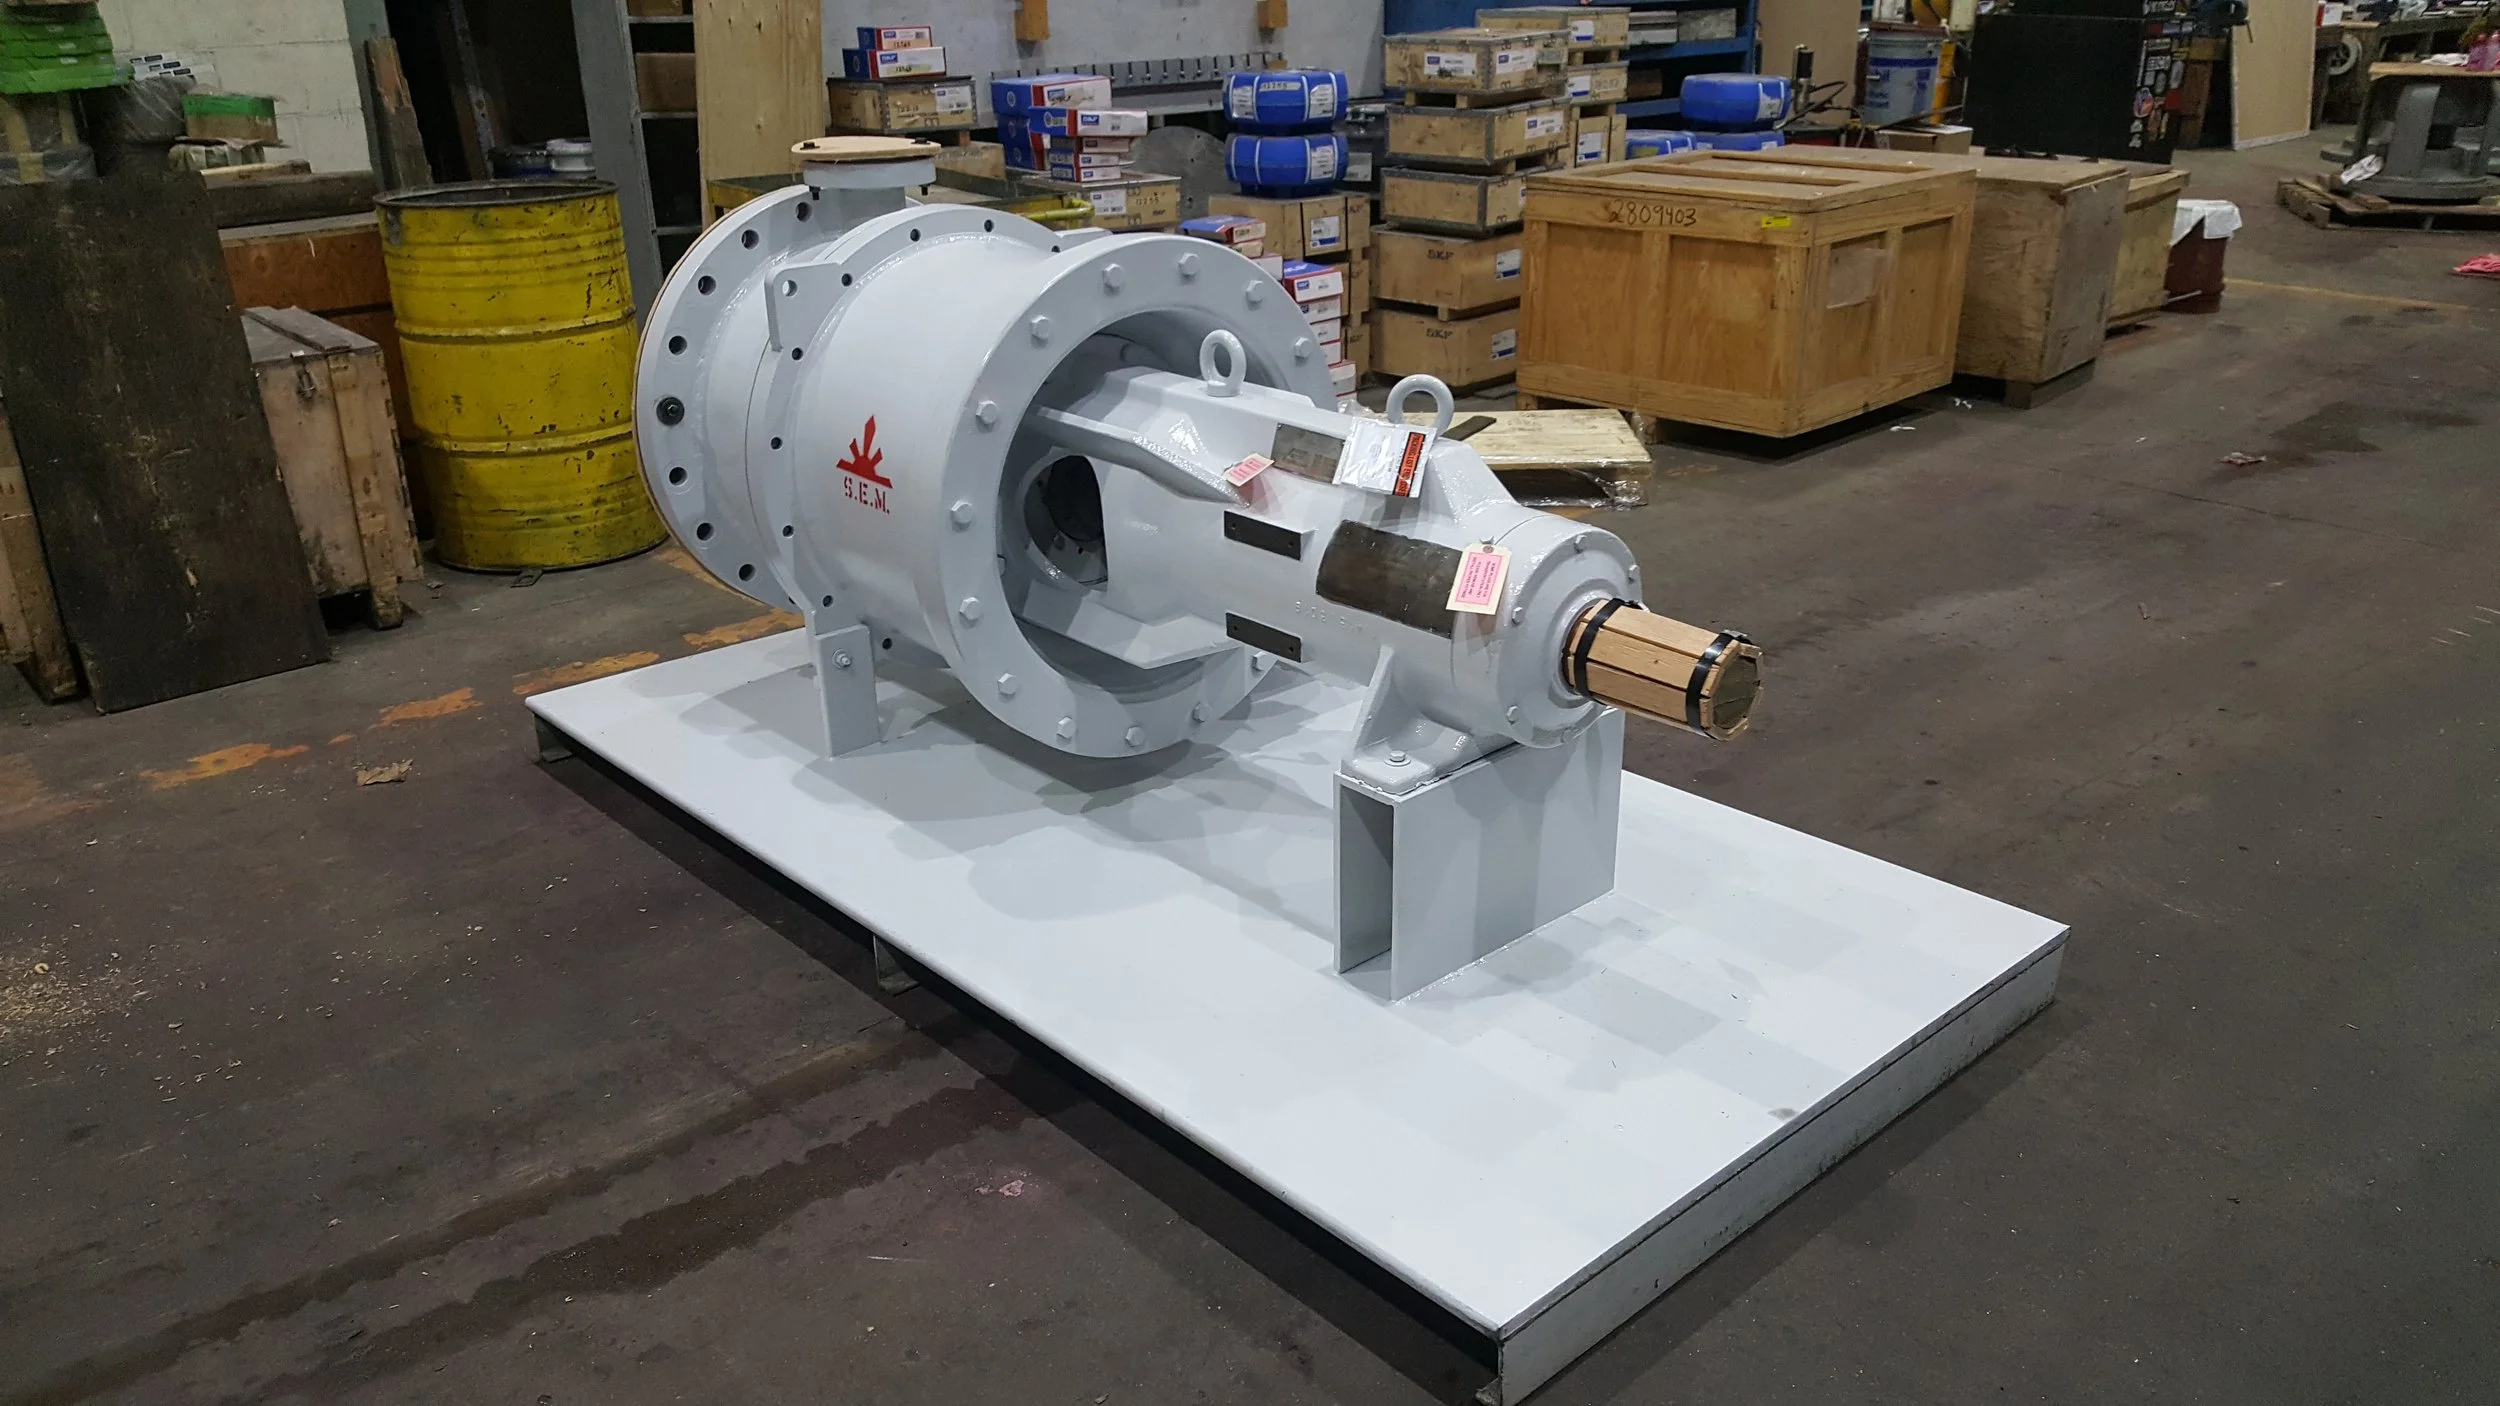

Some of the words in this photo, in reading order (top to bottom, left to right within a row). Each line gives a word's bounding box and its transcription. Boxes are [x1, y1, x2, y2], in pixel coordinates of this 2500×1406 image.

[1082, 115, 1099, 123] SKF
[1608, 200, 1697, 227] 2809403
[1427, 249, 1454, 260] SKF
[1426, 327, 1453, 339] SKF
[1405, 456, 1414, 468] LIST
